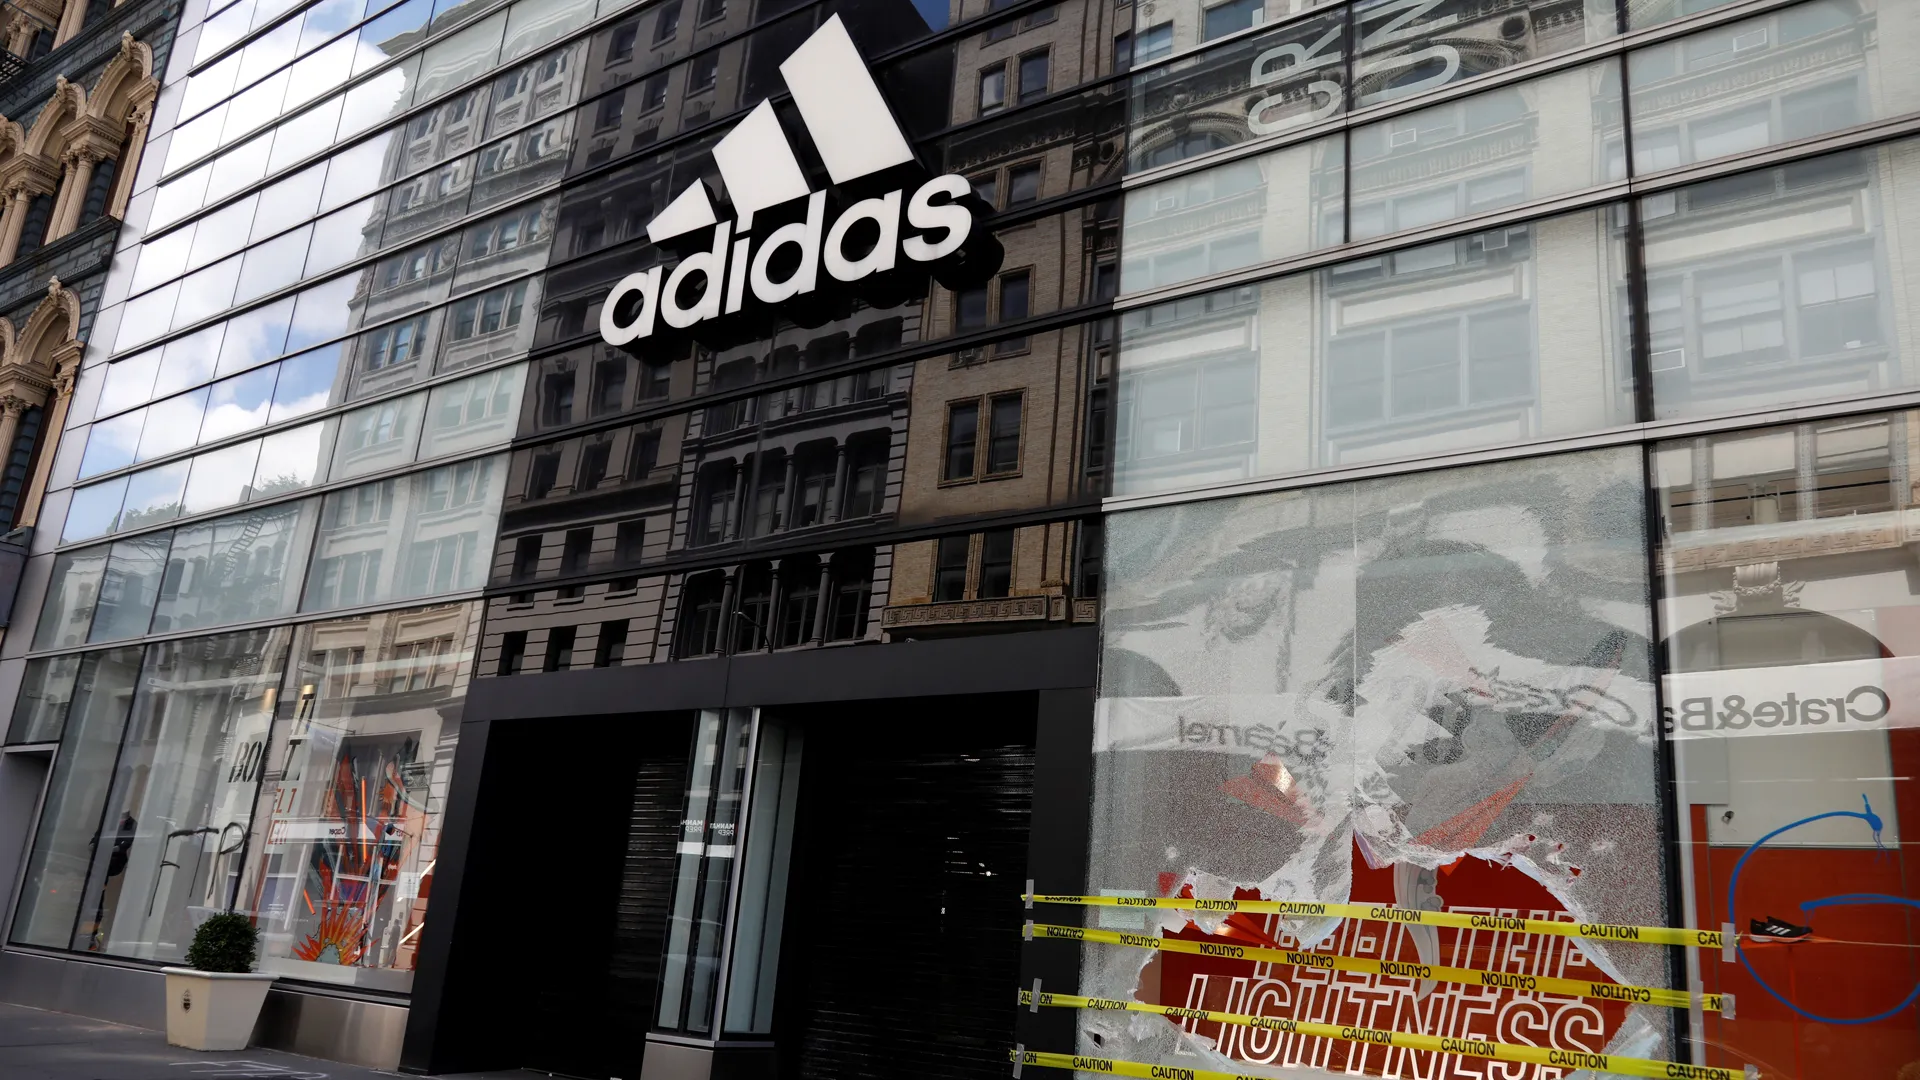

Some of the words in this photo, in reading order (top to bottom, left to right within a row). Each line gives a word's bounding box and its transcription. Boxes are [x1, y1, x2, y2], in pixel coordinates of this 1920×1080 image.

[1248, 8, 1342, 135] CR
[600, 173, 972, 346] adidas
[1117, 897, 1157, 907] CAUTION
[1195, 900, 1238, 911] CAUTION
[1279, 903, 1326, 915] CAUTION
[1371, 907, 1422, 922] CAUTION
[1470, 915, 1526, 930] CAUTION
[1579, 923, 1640, 940] CAUTION
[1046, 926, 1084, 939] CAUTION
[1120, 934, 1160, 948] CAUTION
[1199, 944, 1244, 958] CAUTION
[1286, 952, 1334, 967] CAUTION
[1380, 961, 1431, 978] CAUTION
[1481, 972, 1536, 990] CAUTION
[1591, 983, 1650, 1003] CAUTION
[1073, 1057, 1113, 1072] CAUTION
[1151, 1066, 1194, 1080] CAUTION
[1087, 998, 1127, 1011] CAUTION
[1165, 1007, 1209, 1020] CAUTION
[1250, 1016, 1297, 1032] CAUTION
[1342, 1028, 1392, 1044] CAUTION
[1441, 1038, 1496, 1056] CAUTION
[1549, 1050, 1608, 1069] CAUTION
[1666, 1064, 1730, 1080] CAUTION
